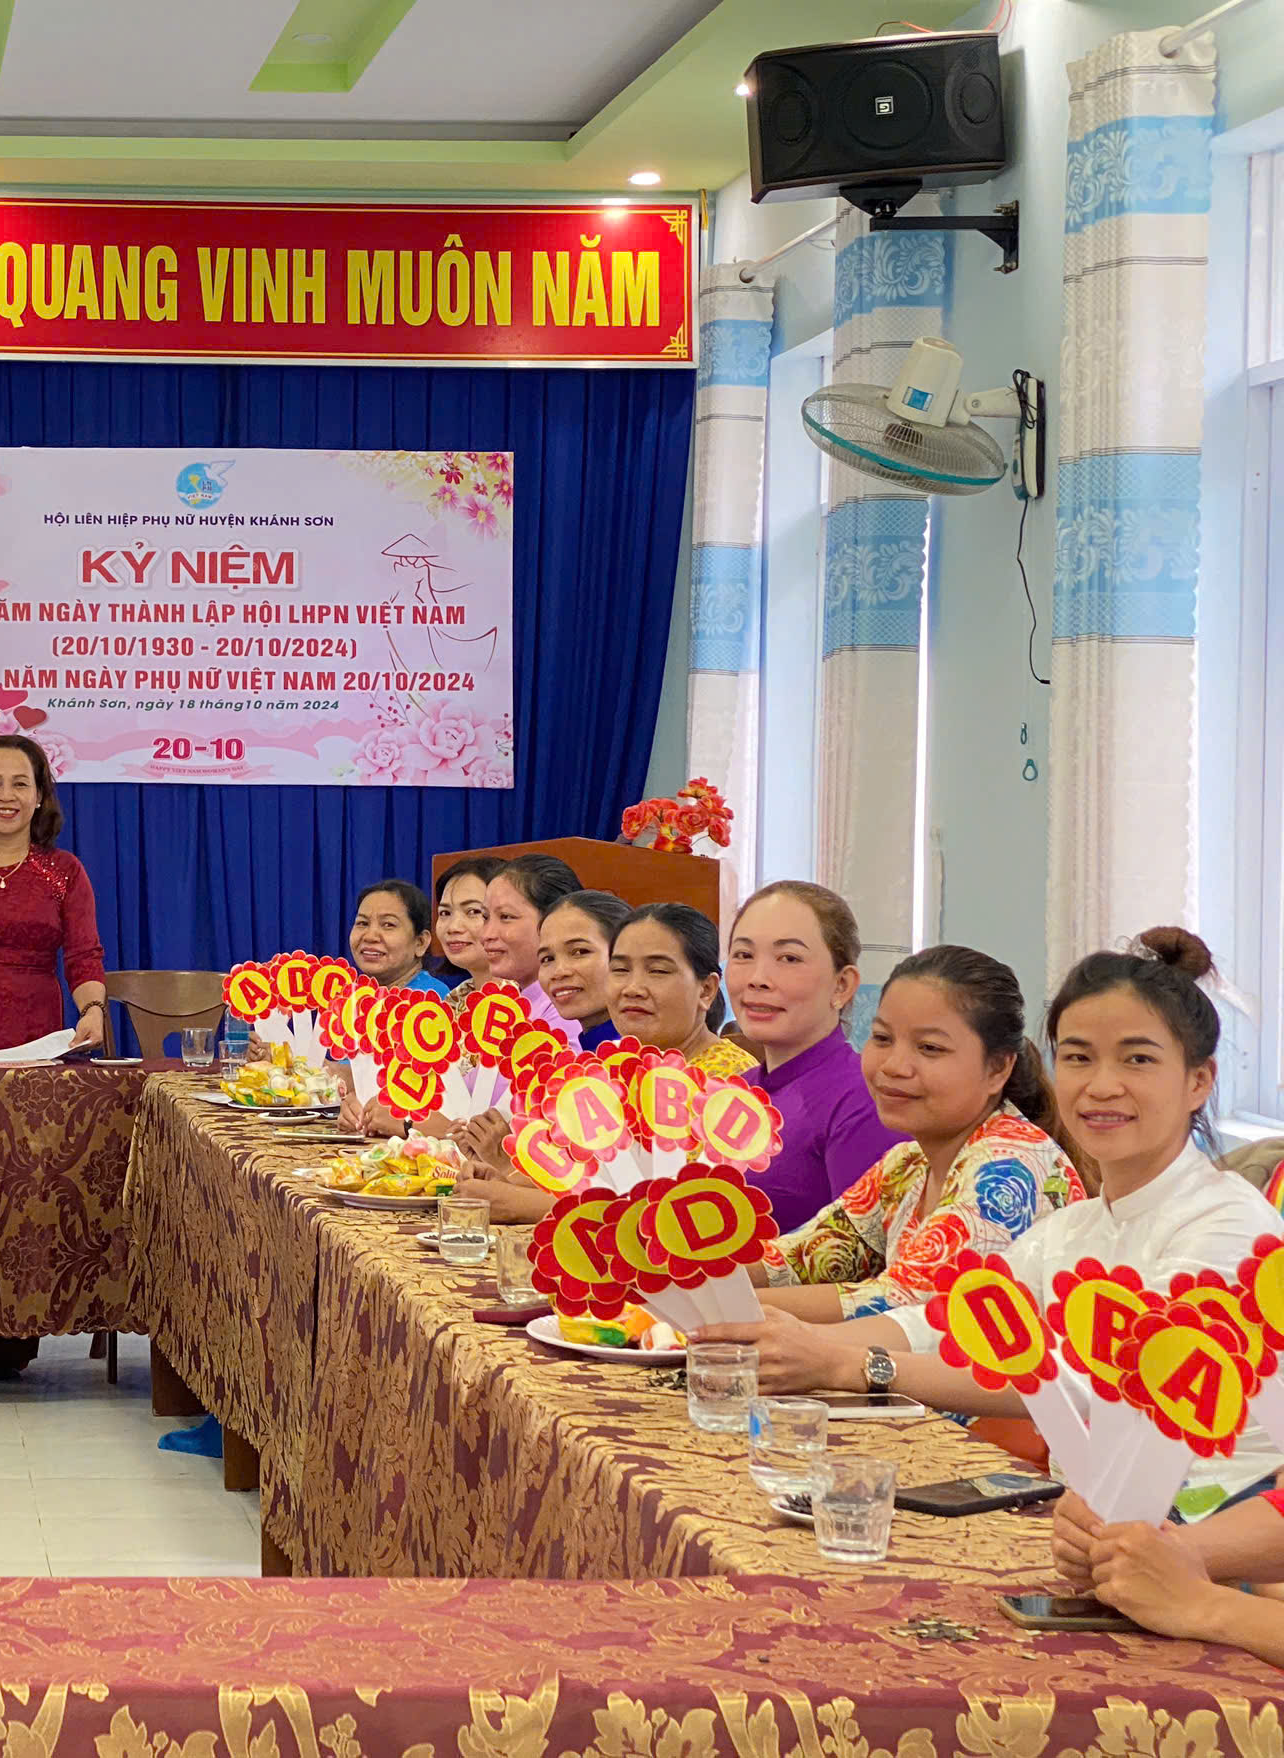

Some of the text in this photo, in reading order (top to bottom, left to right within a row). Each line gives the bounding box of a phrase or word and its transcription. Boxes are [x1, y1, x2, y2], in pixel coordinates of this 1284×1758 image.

[197, 247, 327, 325] VINH
[346, 233, 513, 327] MUÔN
[532, 236, 661, 327] NĂM
[43, 511, 334, 528] HỘI LIÊN HIỆP PHỤ NỮ HUYỆN KHÁNH SƠN
[81, 541, 295, 589] KỶ NIỆM
[38, 599, 102, 622] NGÀY
[108, 600, 185, 623] THÀNH
[192, 600, 235, 627] LẬP
[243, 600, 281, 628] HỘI
[288, 604, 349, 624] LHPN
[356, 601, 405, 628] VIỆT
[412, 605, 465, 625] NAM
[52, 636, 195, 657] (20/10/1930
[216, 637, 357, 660] 20/10/2024)
[4, 665, 58, 689] NĂM
[66, 666, 128, 689] NGÀY
[134, 670, 181, 694] PHỤ
[188, 667, 222, 690] NỮ
[227, 667, 277, 694] VIỆT
[283, 671, 336, 691] NAM
[343, 672, 475, 692] 20/10/2024
[47, 698, 96, 709] Khánh
[99, 699, 132, 711] Sơn,
[135, 699, 174, 712] ngày
[179, 699, 196, 710] 18
[266, 700, 299, 711] năm
[302, 700, 340, 711] 2024
[153, 738, 245, 761] 20-10
[238, 976, 268, 1010] A
[414, 1009, 448, 1052] C
[482, 1000, 518, 1046] B
[573, 1086, 620, 1142] A
[655, 1076, 690, 1128] B
[712, 1095, 761, 1151] D
[670, 1190, 738, 1252] D
[963, 1283, 1032, 1362] D
[1158, 1346, 1223, 1433] A
